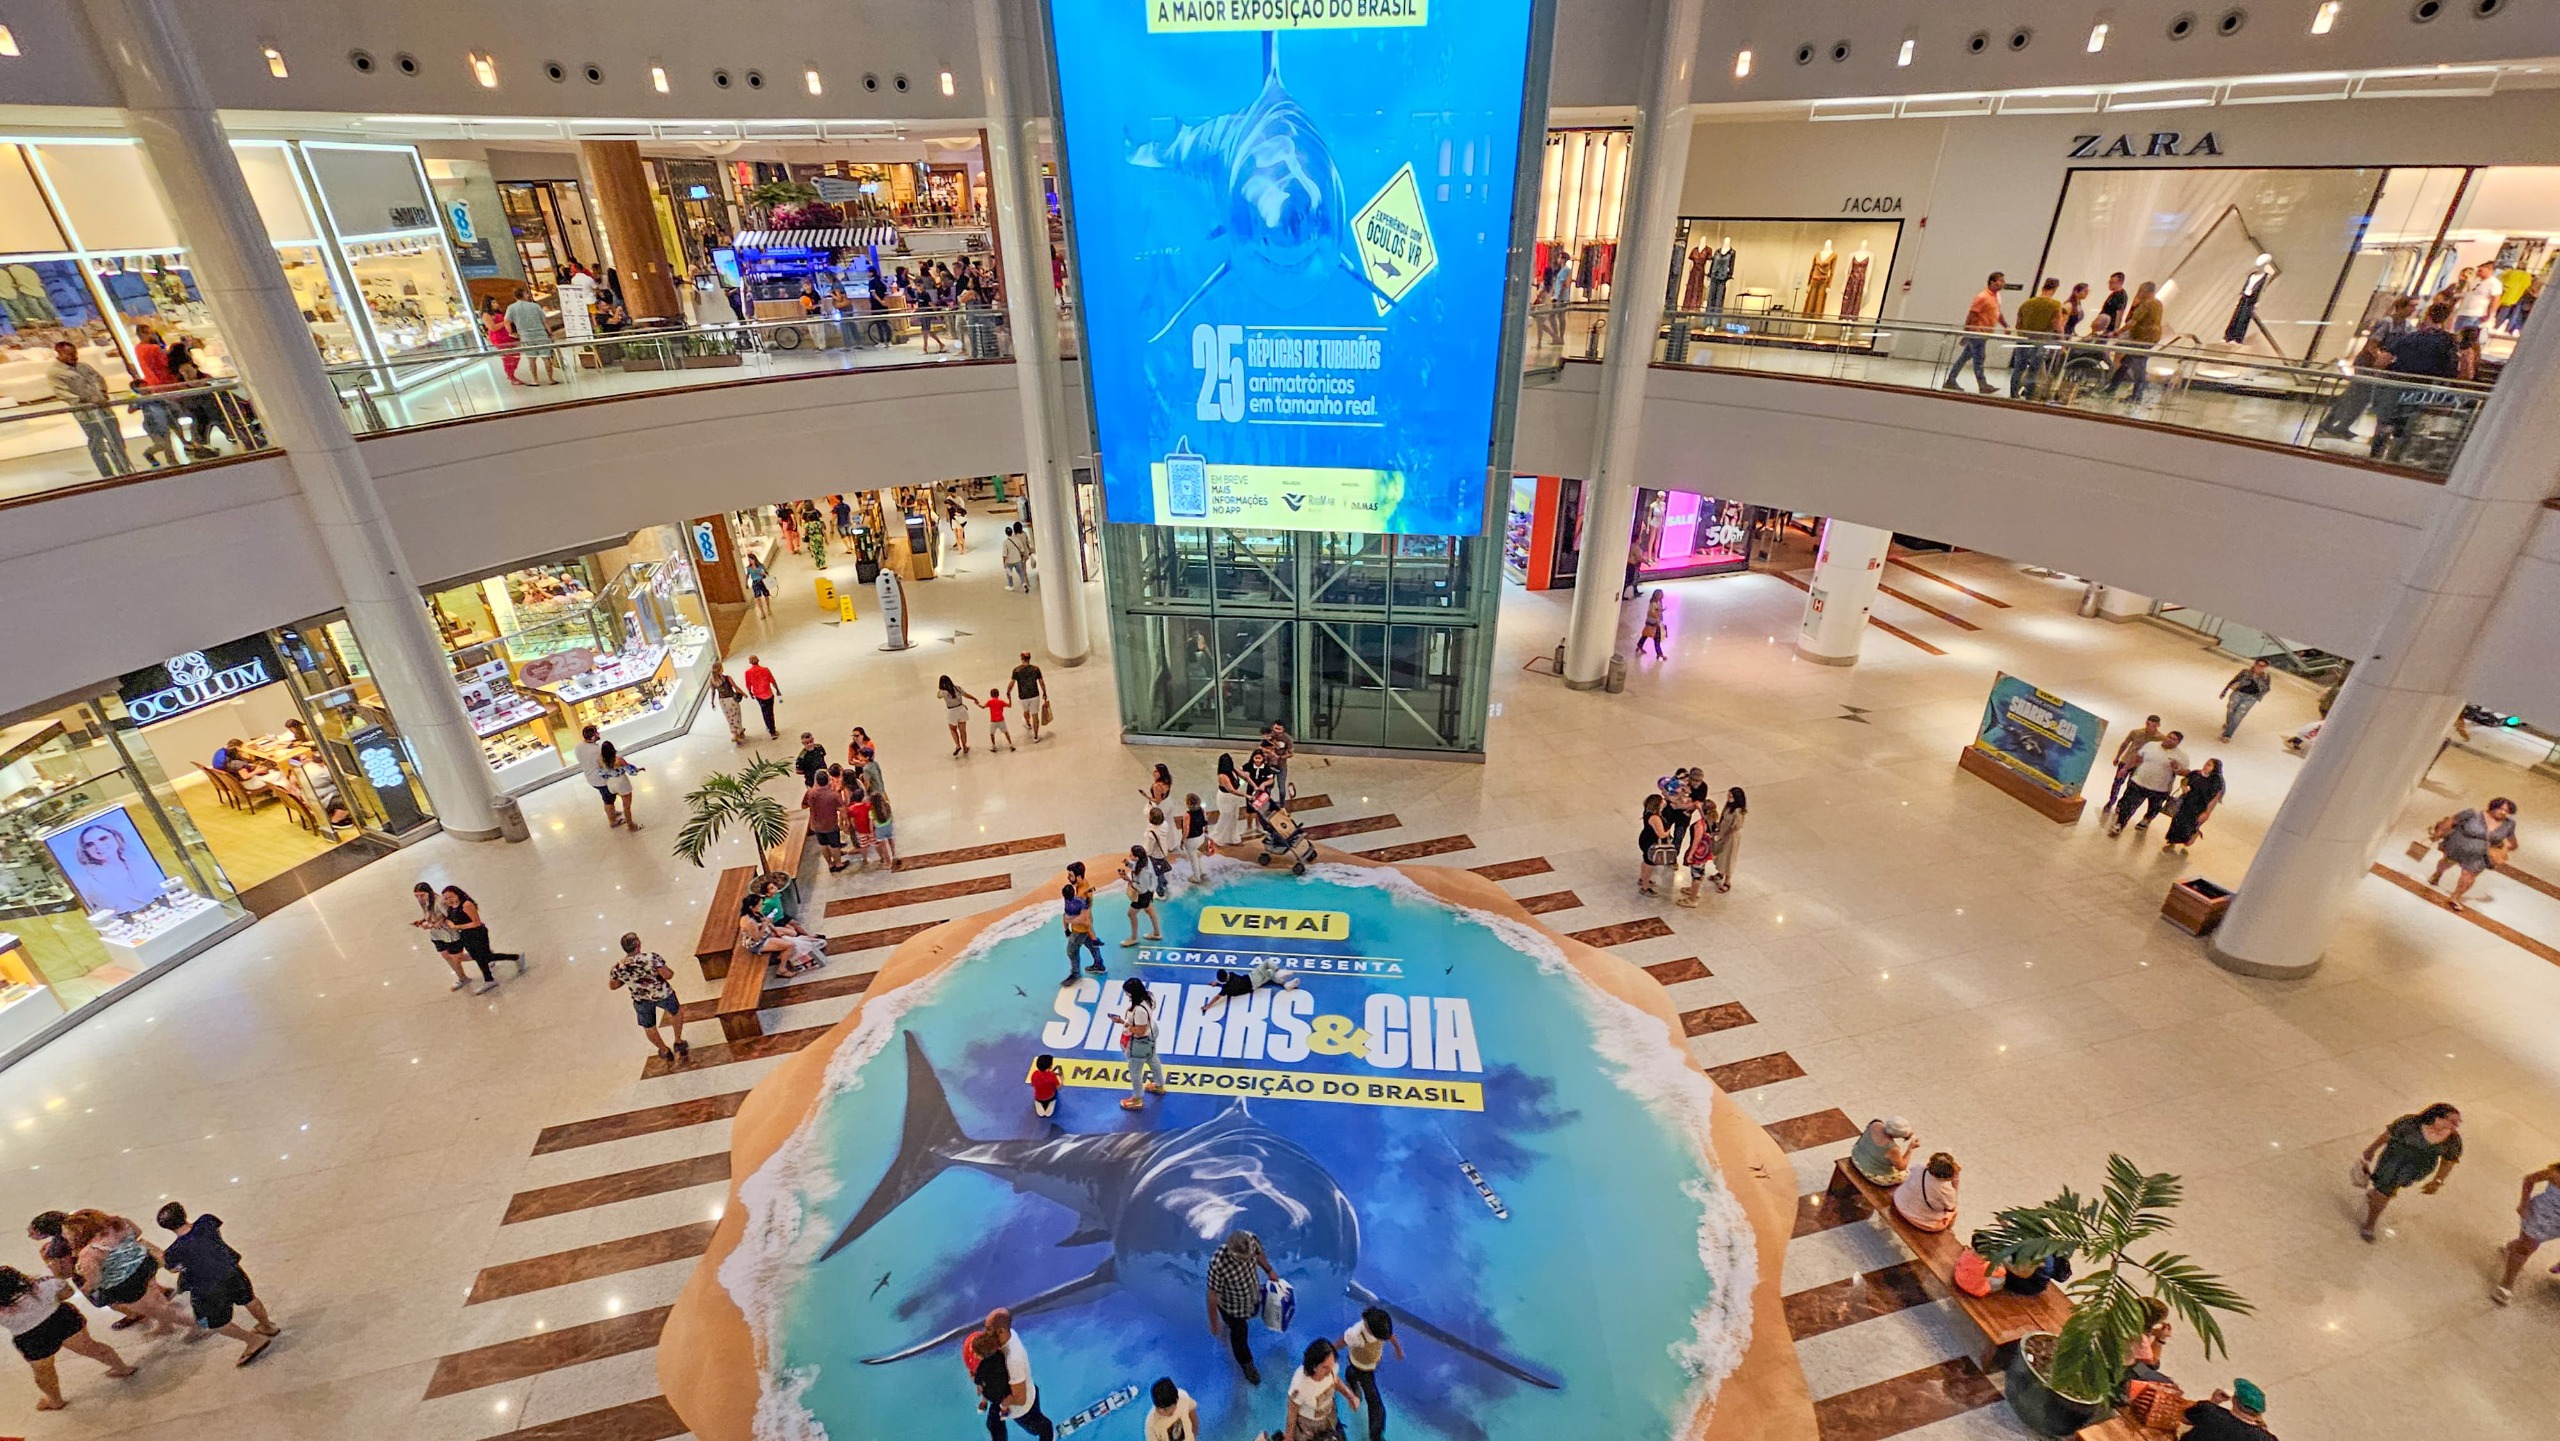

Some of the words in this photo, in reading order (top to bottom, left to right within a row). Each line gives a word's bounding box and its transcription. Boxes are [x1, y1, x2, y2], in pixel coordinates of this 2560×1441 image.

[1158, 2, 1169, 23] A
[1173, 1, 1226, 22] MAIOR
[1329, 0, 1352, 18] DO
[1358, 0, 1417, 17] BRASIL
[2067, 131, 2224, 158] ZARA
[1841, 197, 1902, 213] SACADA
[1367, 215, 1406, 259] ÓCULOS
[1408, 241, 1422, 268] VR
[1247, 333, 1303, 368] RÉPLICAS
[1303, 339, 1320, 369] DE
[1320, 335, 1382, 370] TUBARÕES
[1192, 323, 1246, 423] 25
[1248, 372, 1356, 395] animatrônicos
[1249, 397, 1274, 413] em
[1275, 394, 1344, 415] tamanho
[1345, 395, 1379, 416] real.
[1211, 485, 1231, 495] MAIS
[1212, 493, 1269, 509] INFORMAÇÕES
[1667, 513, 1695, 527] SALE
[129, 662, 270, 721] OCULUM
[1220, 913, 1288, 931] VEM
[1296, 913, 1330, 932] AÍ
[1138, 950, 1238, 965] RIOMAR
[1250, 956, 1404, 974] APRESENTA
[1165, 1070, 1317, 1097] EXPOSIÇÃO
[1324, 1080, 1360, 1099] DO
[1368, 1084, 1466, 1105] BRASIL
